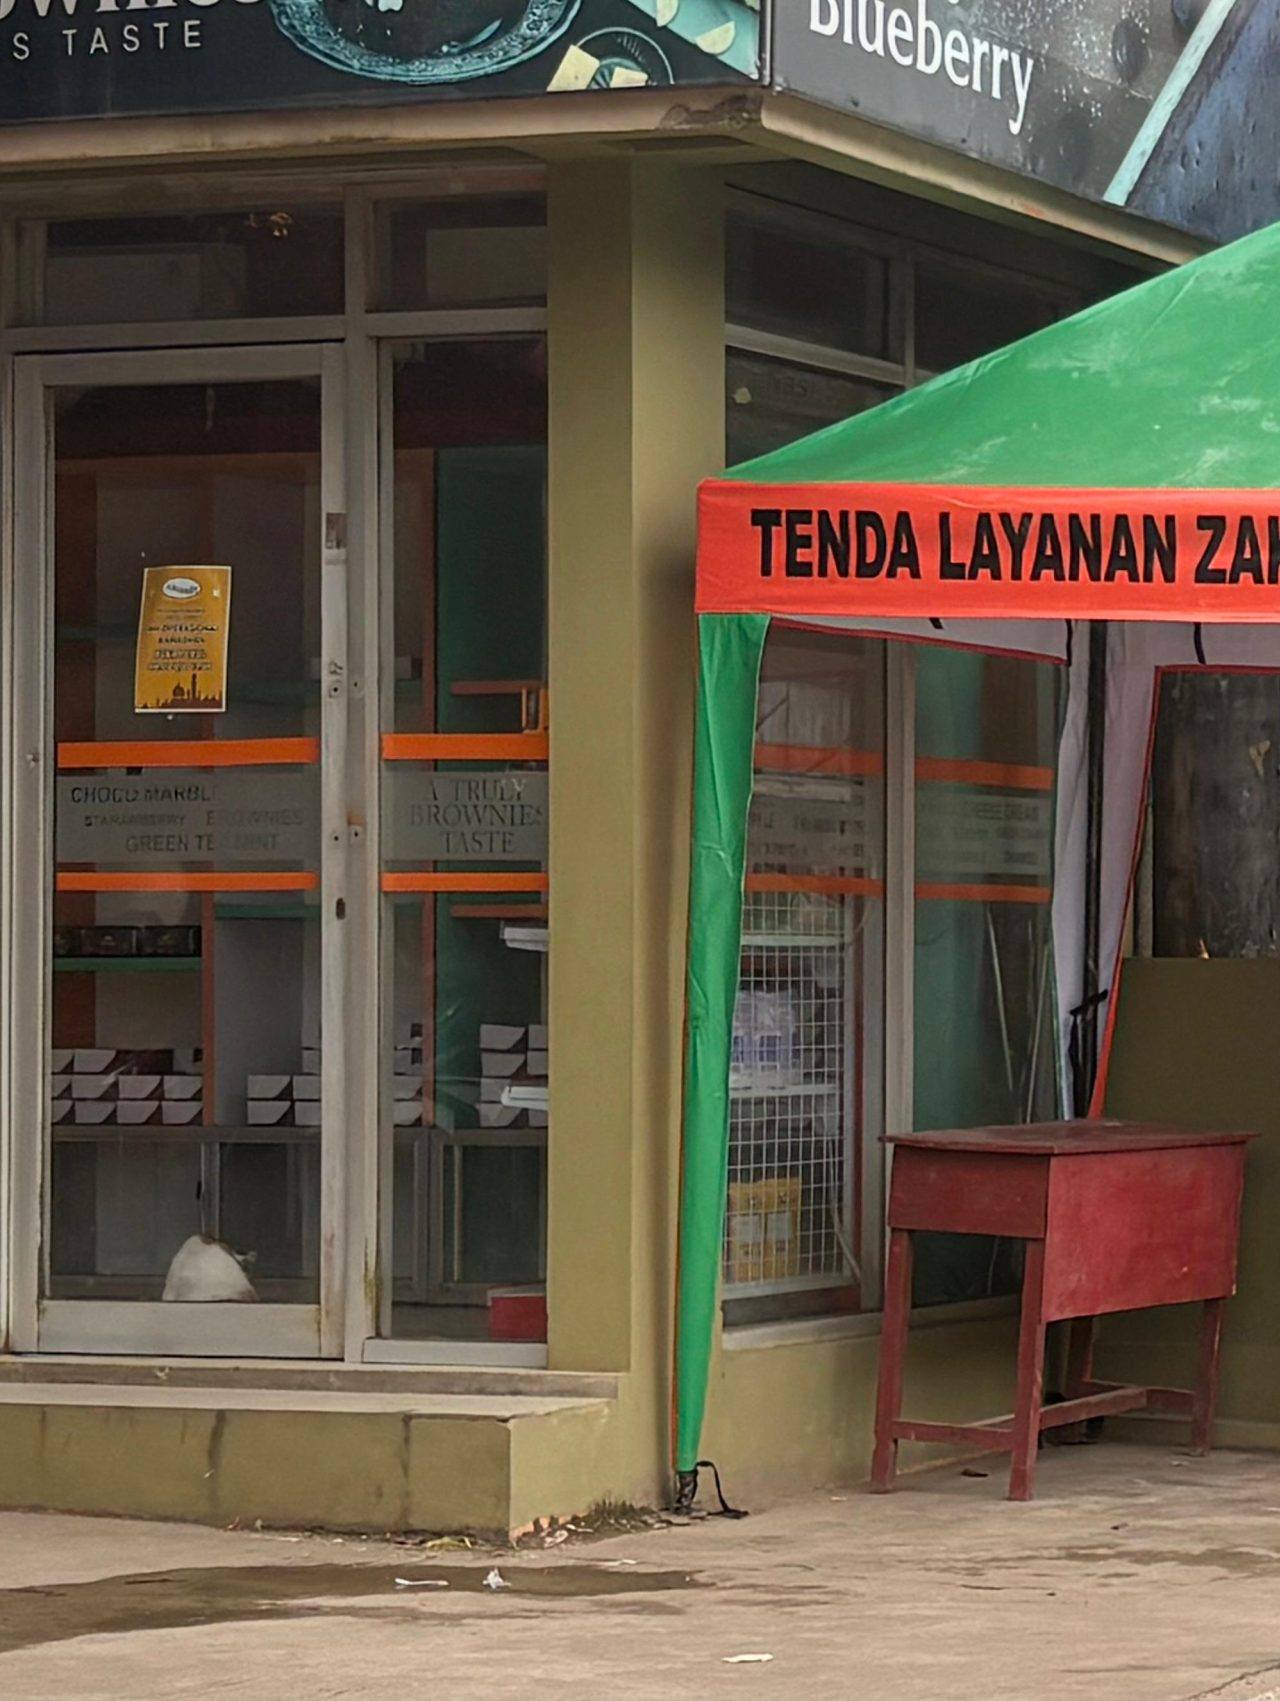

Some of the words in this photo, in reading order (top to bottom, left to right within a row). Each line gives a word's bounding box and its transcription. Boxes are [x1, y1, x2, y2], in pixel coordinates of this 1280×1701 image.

[62, 20, 201, 56] TASTE
[751, 508, 921, 579] TENDA
[939, 511, 1176, 584] LAYANAN
[450, 778, 526, 801] TRULY
[410, 804, 544, 827] BROWNIES
[126, 834, 189, 853] GREEN
[440, 831, 516, 853] TASTE
